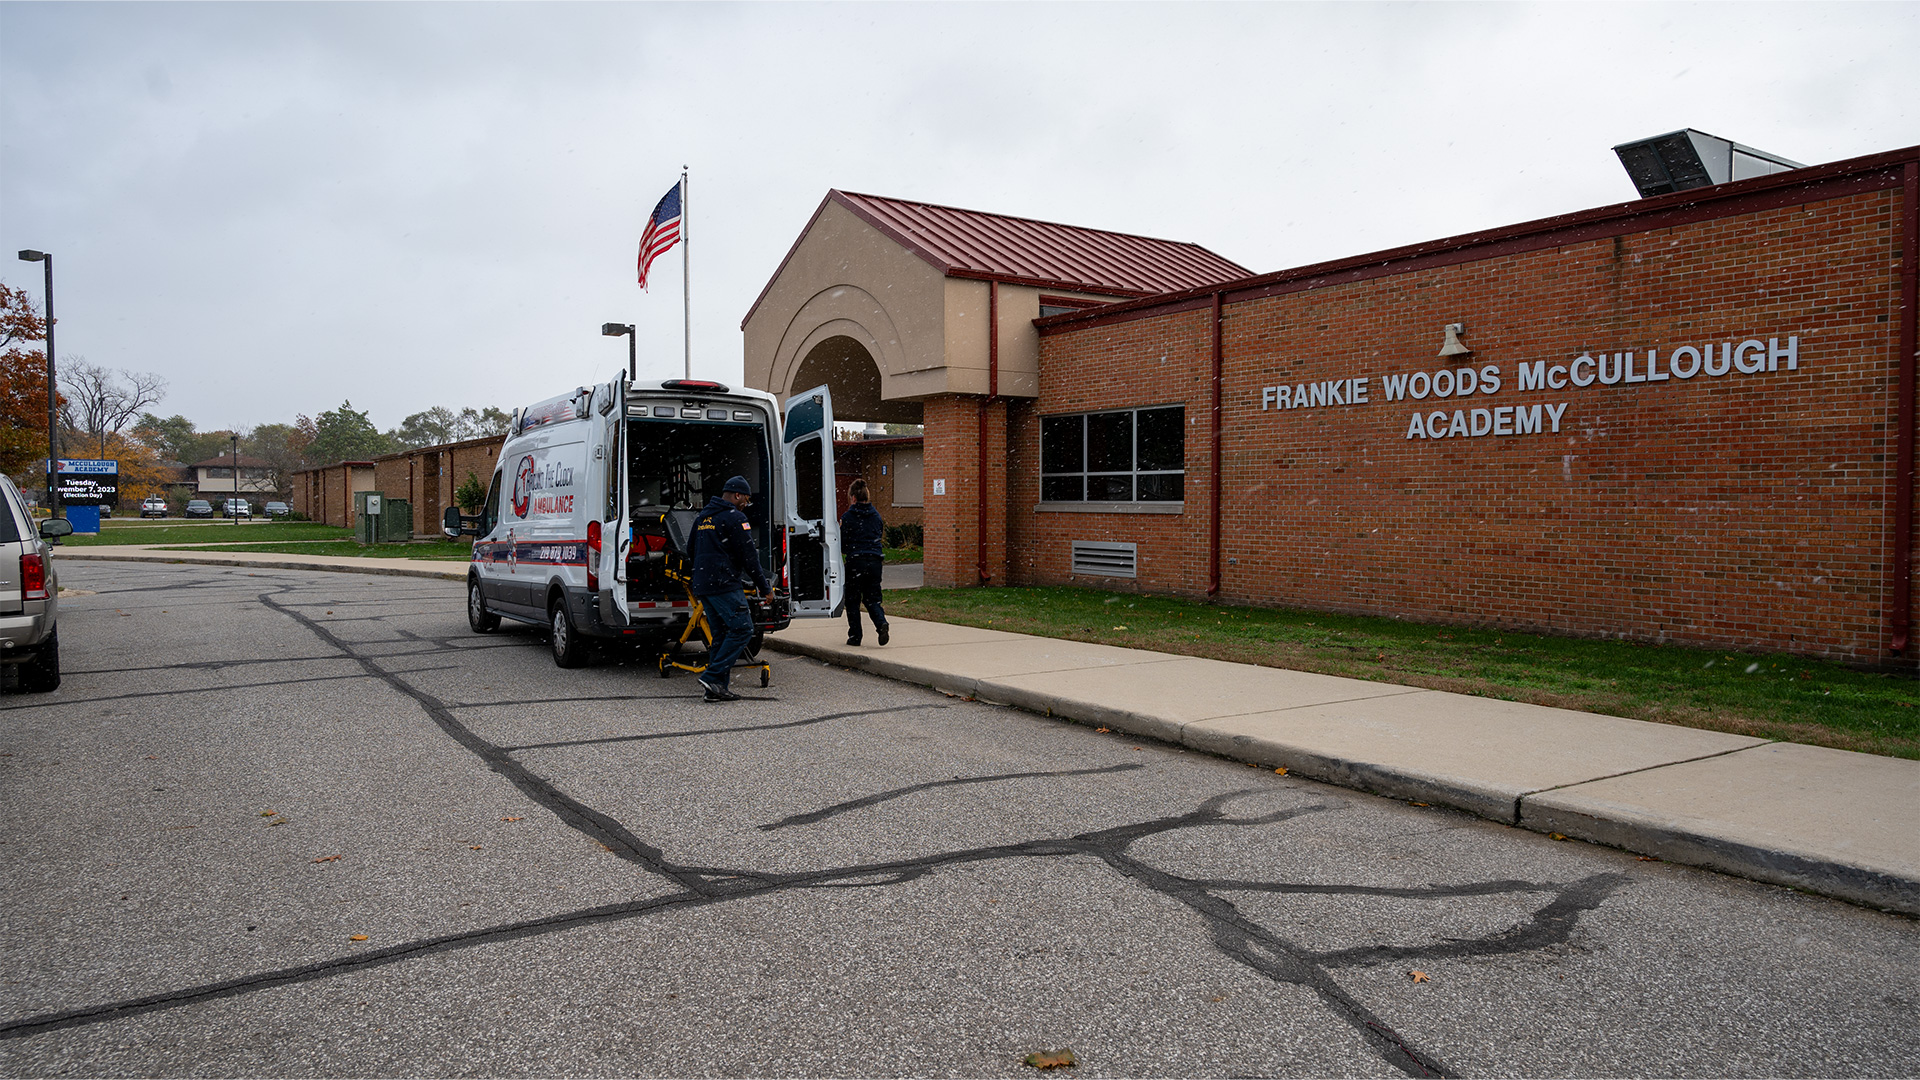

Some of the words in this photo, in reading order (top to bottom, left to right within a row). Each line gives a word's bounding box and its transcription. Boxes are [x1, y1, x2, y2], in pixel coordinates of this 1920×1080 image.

[1262, 377, 1369, 411] FRANKIE
[1382, 365, 1501, 402] WOODS
[1518, 336, 1799, 392] McCULLOUGH
[1406, 402, 1568, 440] ACADEMY
[65, 479, 99, 487] Tuesday,
[533, 495, 574, 515] AMBULANCE
